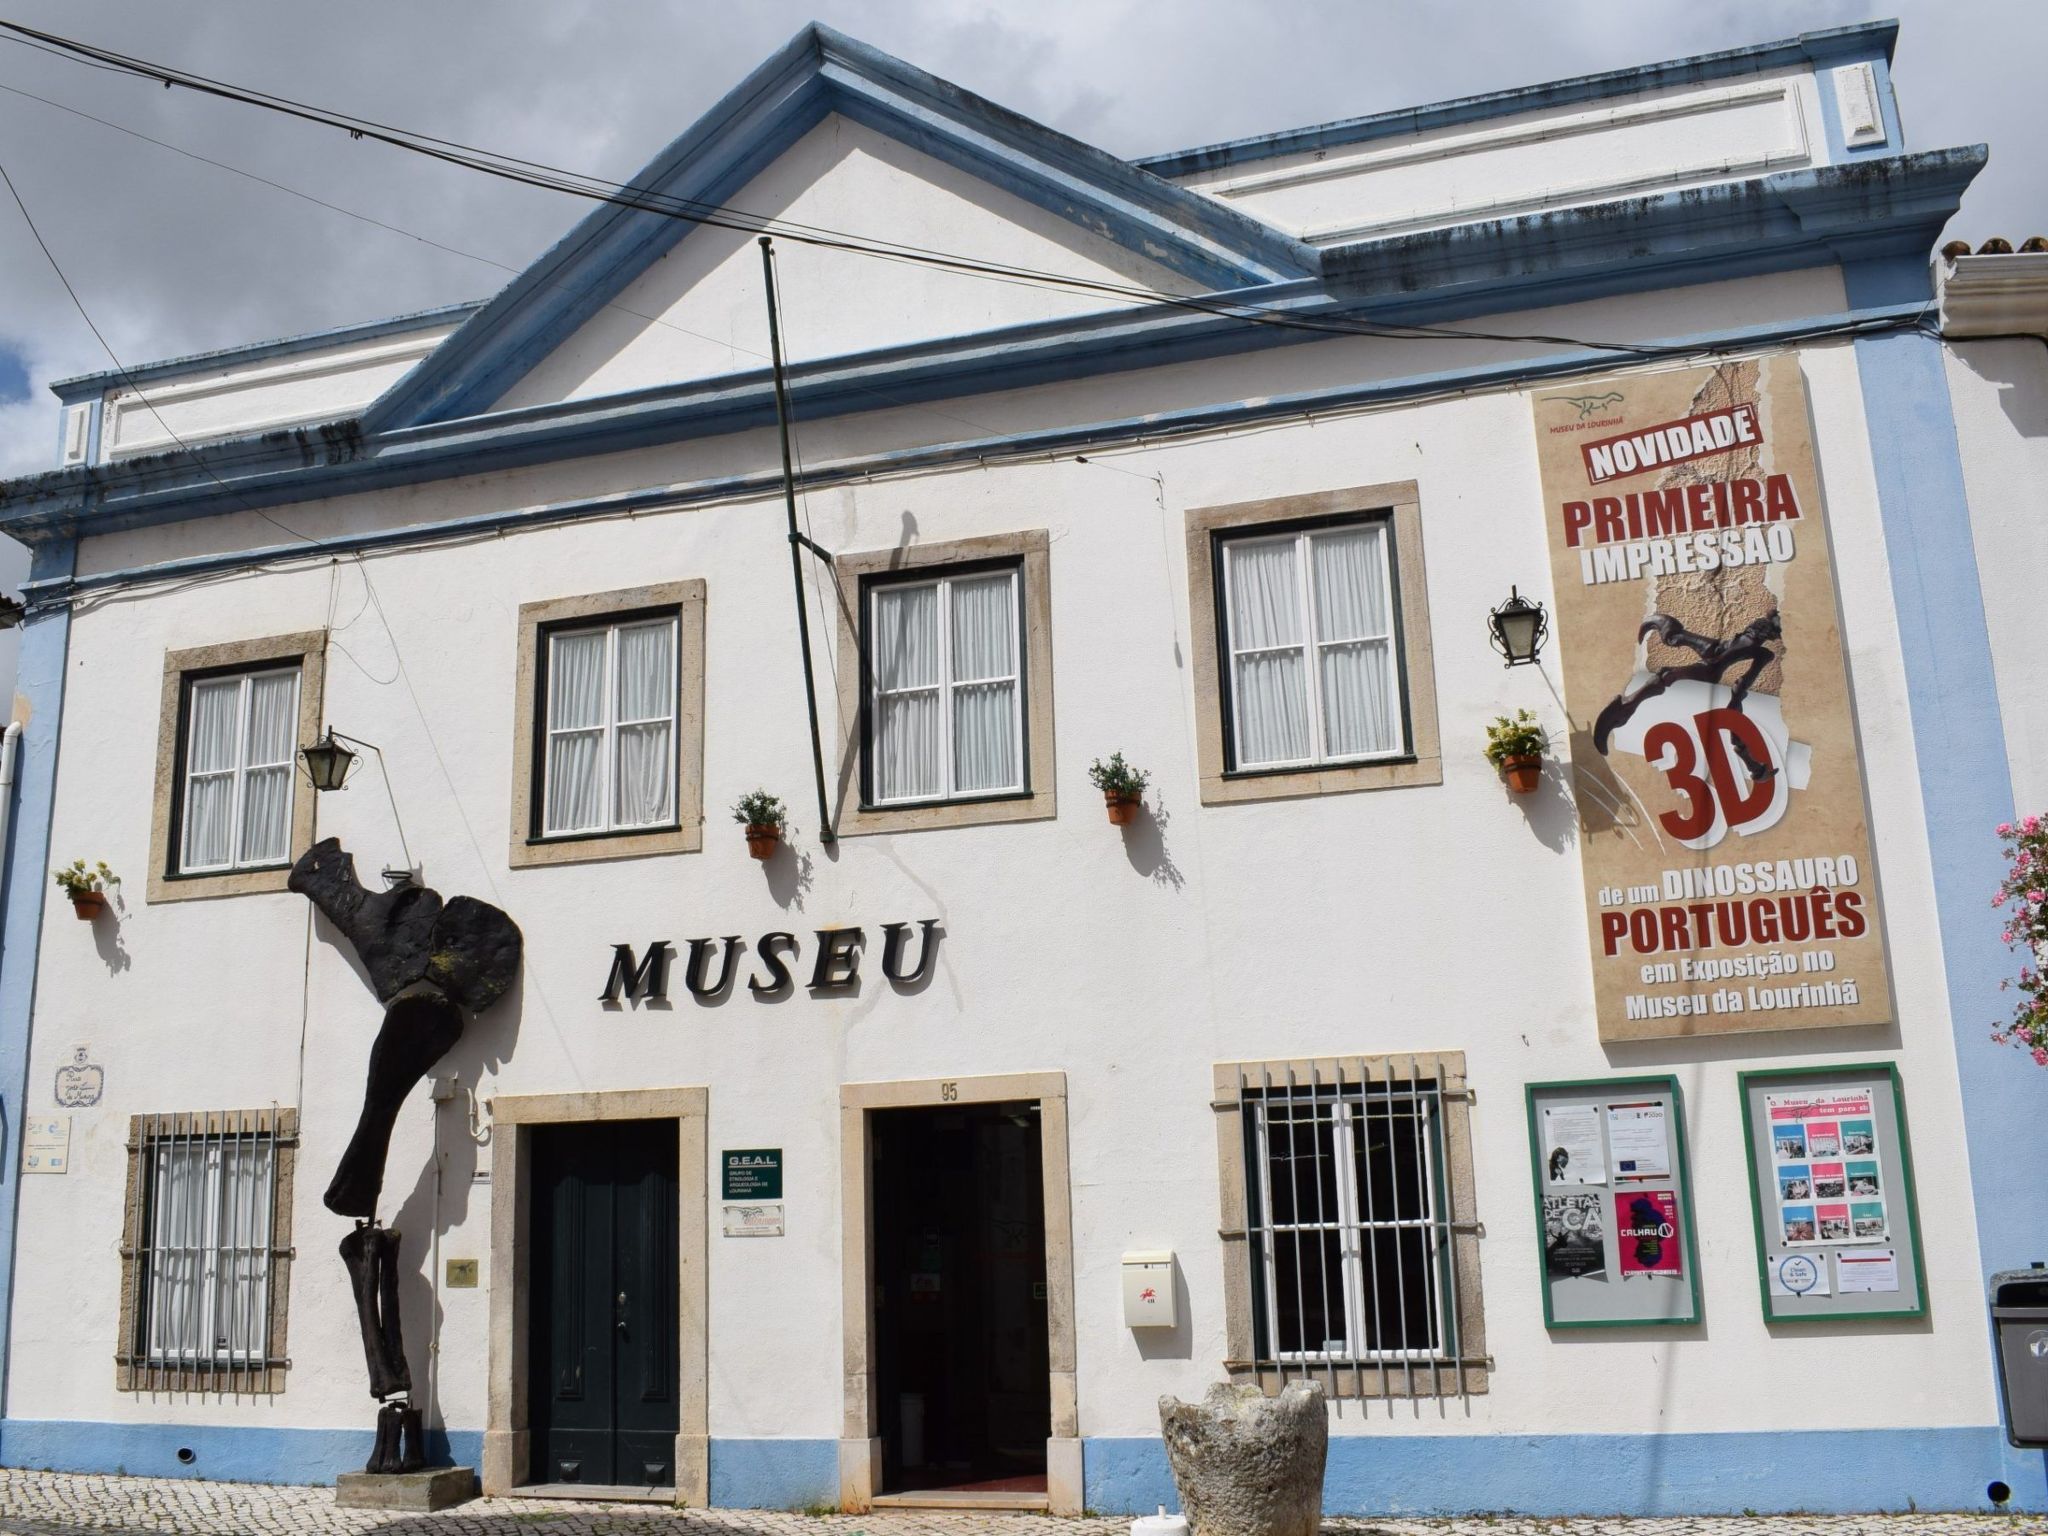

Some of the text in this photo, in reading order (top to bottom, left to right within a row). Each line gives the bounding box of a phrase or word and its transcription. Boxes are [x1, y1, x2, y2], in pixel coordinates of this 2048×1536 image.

[1589, 409, 1756, 480] NOVIDADE
[1562, 474, 1803, 548] PRIMEIRA
[1580, 521, 1796, 585] IMPRESSÃO
[1643, 707, 1776, 840] 3D
[1599, 855, 1858, 906] de um DINOSSAURO
[1601, 885, 1867, 956] PORTUGUÊS
[598, 918, 941, 1002] MUSEU
[1640, 949, 1834, 984] em Exposição no
[1625, 978, 1859, 1021] Museu da Lourinhã
[942, 1082, 958, 1101] 95
[1819, 1106, 1835, 1114] tem
[729, 1155, 777, 1166] G.E.A.L.
[1544, 1196, 1600, 1209] ATLETAS
[1544, 1208, 1561, 1219] DE
